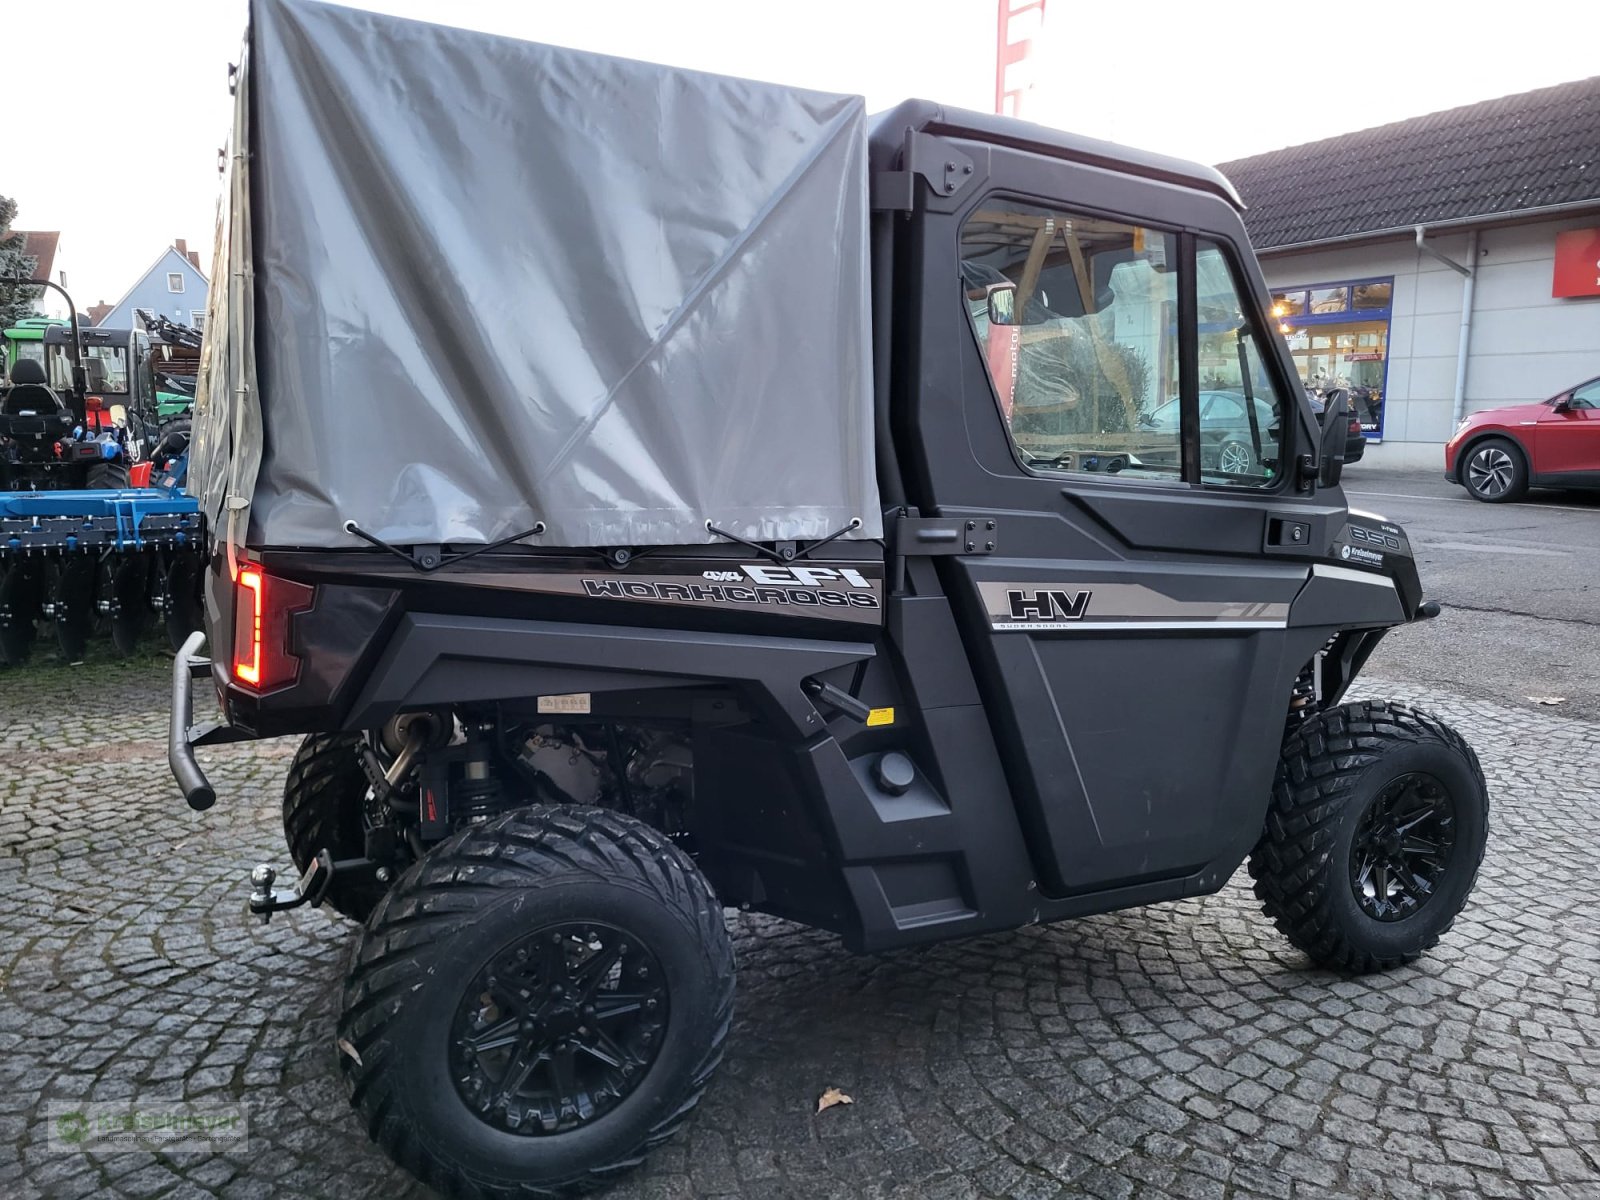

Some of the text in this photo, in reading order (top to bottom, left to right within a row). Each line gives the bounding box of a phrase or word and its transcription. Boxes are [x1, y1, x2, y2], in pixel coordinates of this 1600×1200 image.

[1348, 525, 1401, 551] 850
[739, 564, 874, 589] EFI
[581, 578, 881, 610] WORKCROSS
[1006, 588, 1093, 621] HV
